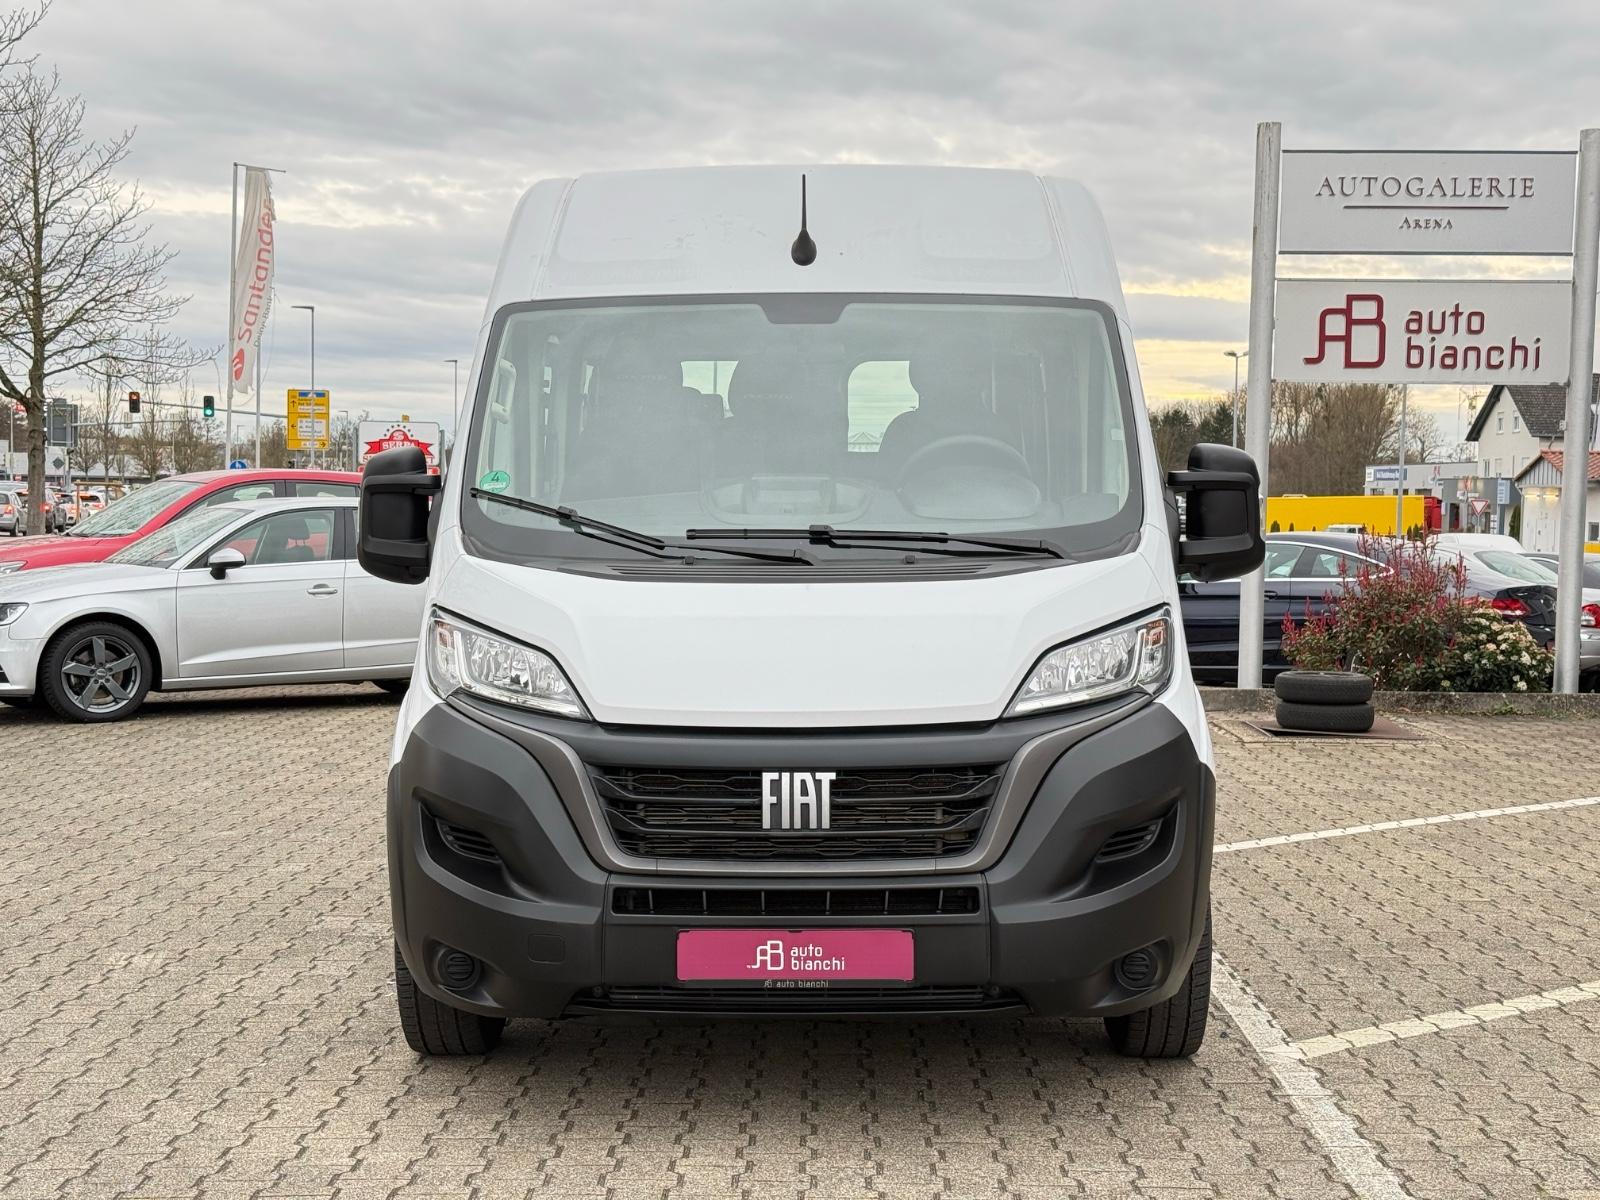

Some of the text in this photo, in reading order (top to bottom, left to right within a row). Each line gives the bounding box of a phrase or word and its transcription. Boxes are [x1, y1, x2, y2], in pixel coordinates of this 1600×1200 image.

[1315, 176, 1535, 198] AUTOGALERIE
[1405, 303, 1485, 335] auto
[1405, 335, 1541, 371] bianchi
[490, 471, 500, 482] 4
[762, 772, 837, 830] FIAT
[790, 943, 824, 957] auto
[791, 957, 845, 971] bianchi
[776, 980, 795, 988] auto
[798, 980, 829, 988] bianchi
